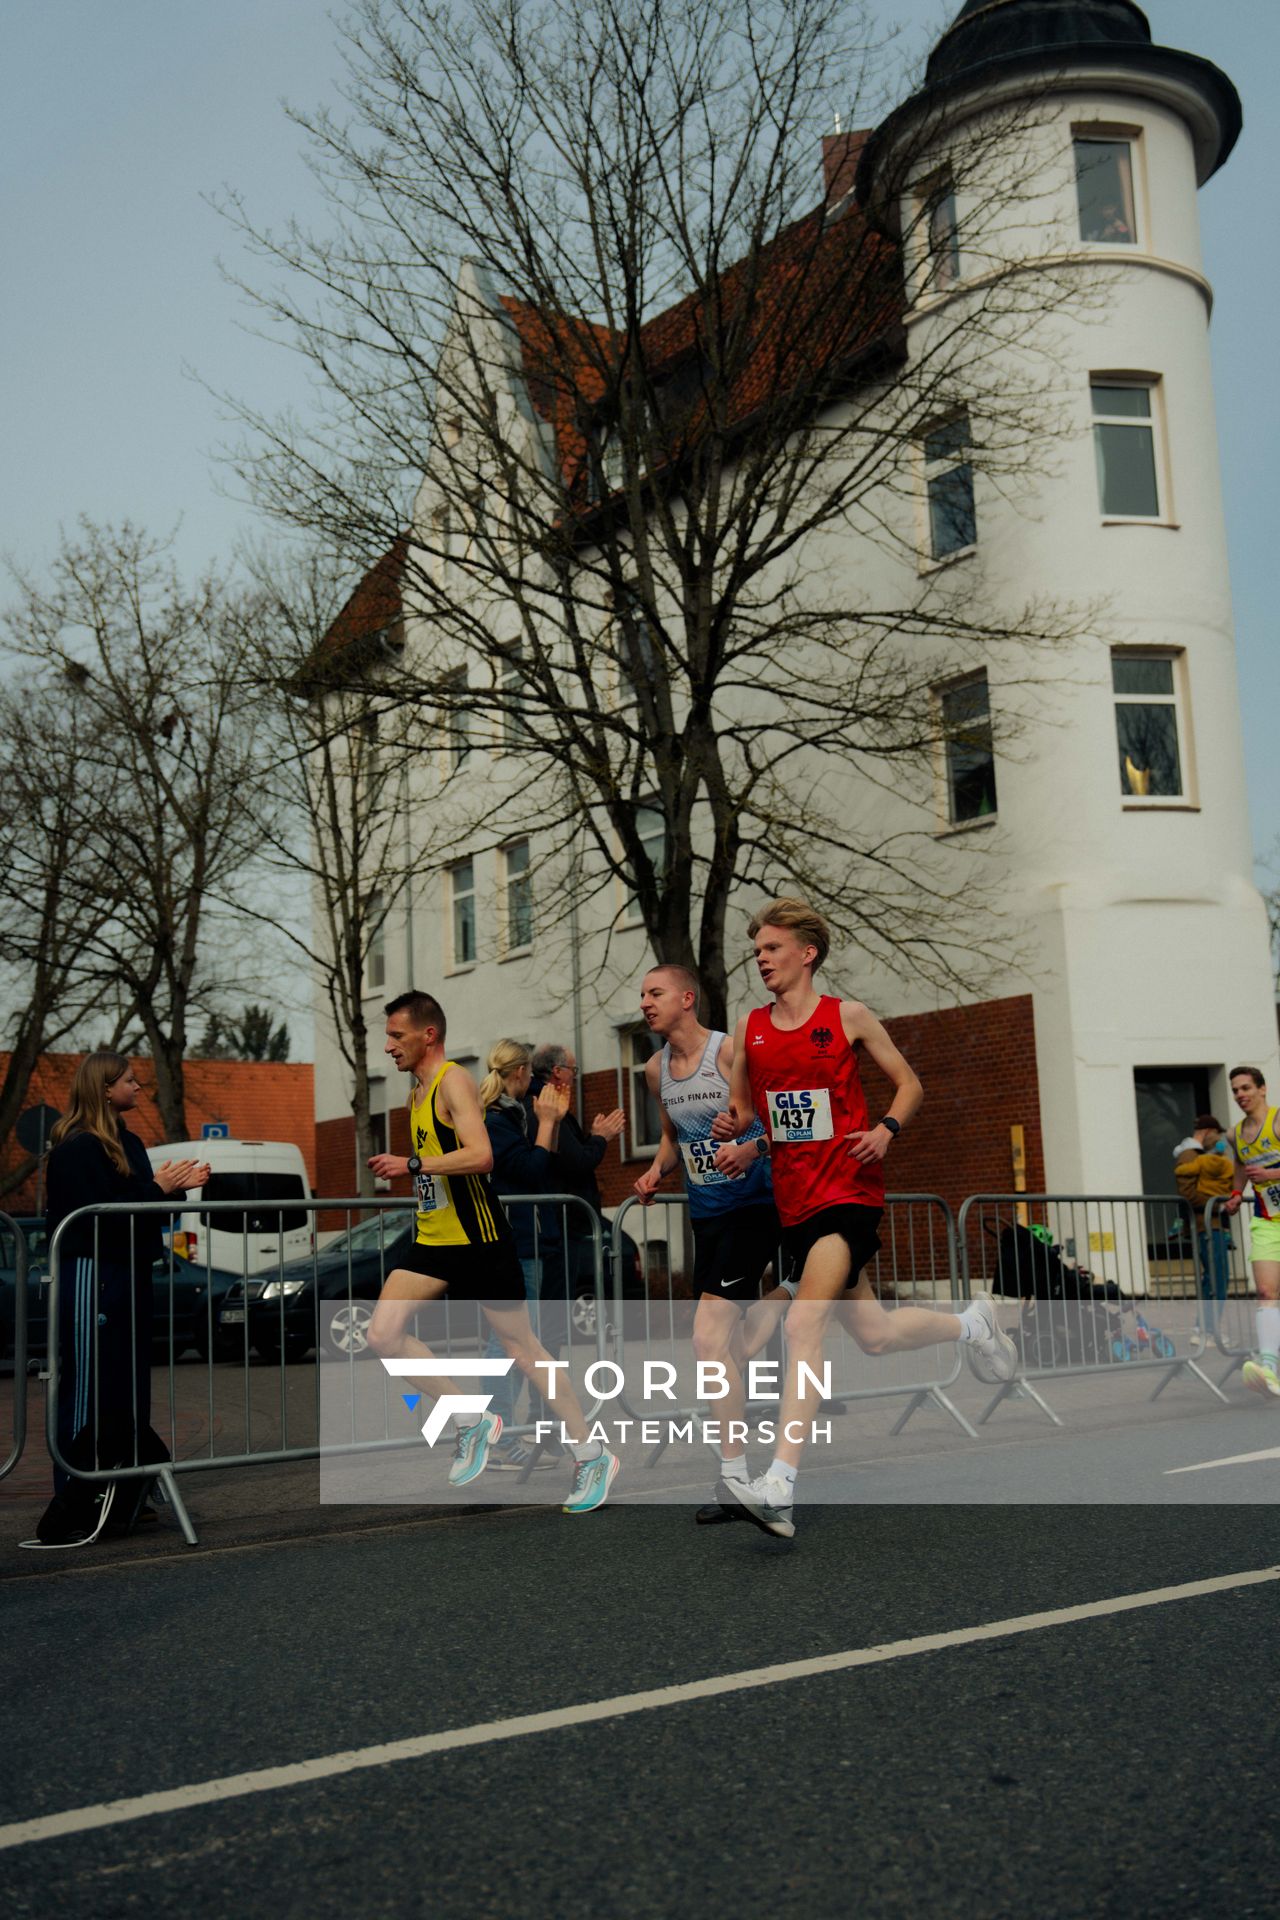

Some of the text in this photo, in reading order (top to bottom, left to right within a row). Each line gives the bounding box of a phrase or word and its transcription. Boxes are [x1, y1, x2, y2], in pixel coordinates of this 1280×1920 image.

[688, 1091, 722, 1102] FINANZ
[780, 1108, 816, 1129] 437
[694, 1155, 718, 1174] 24
